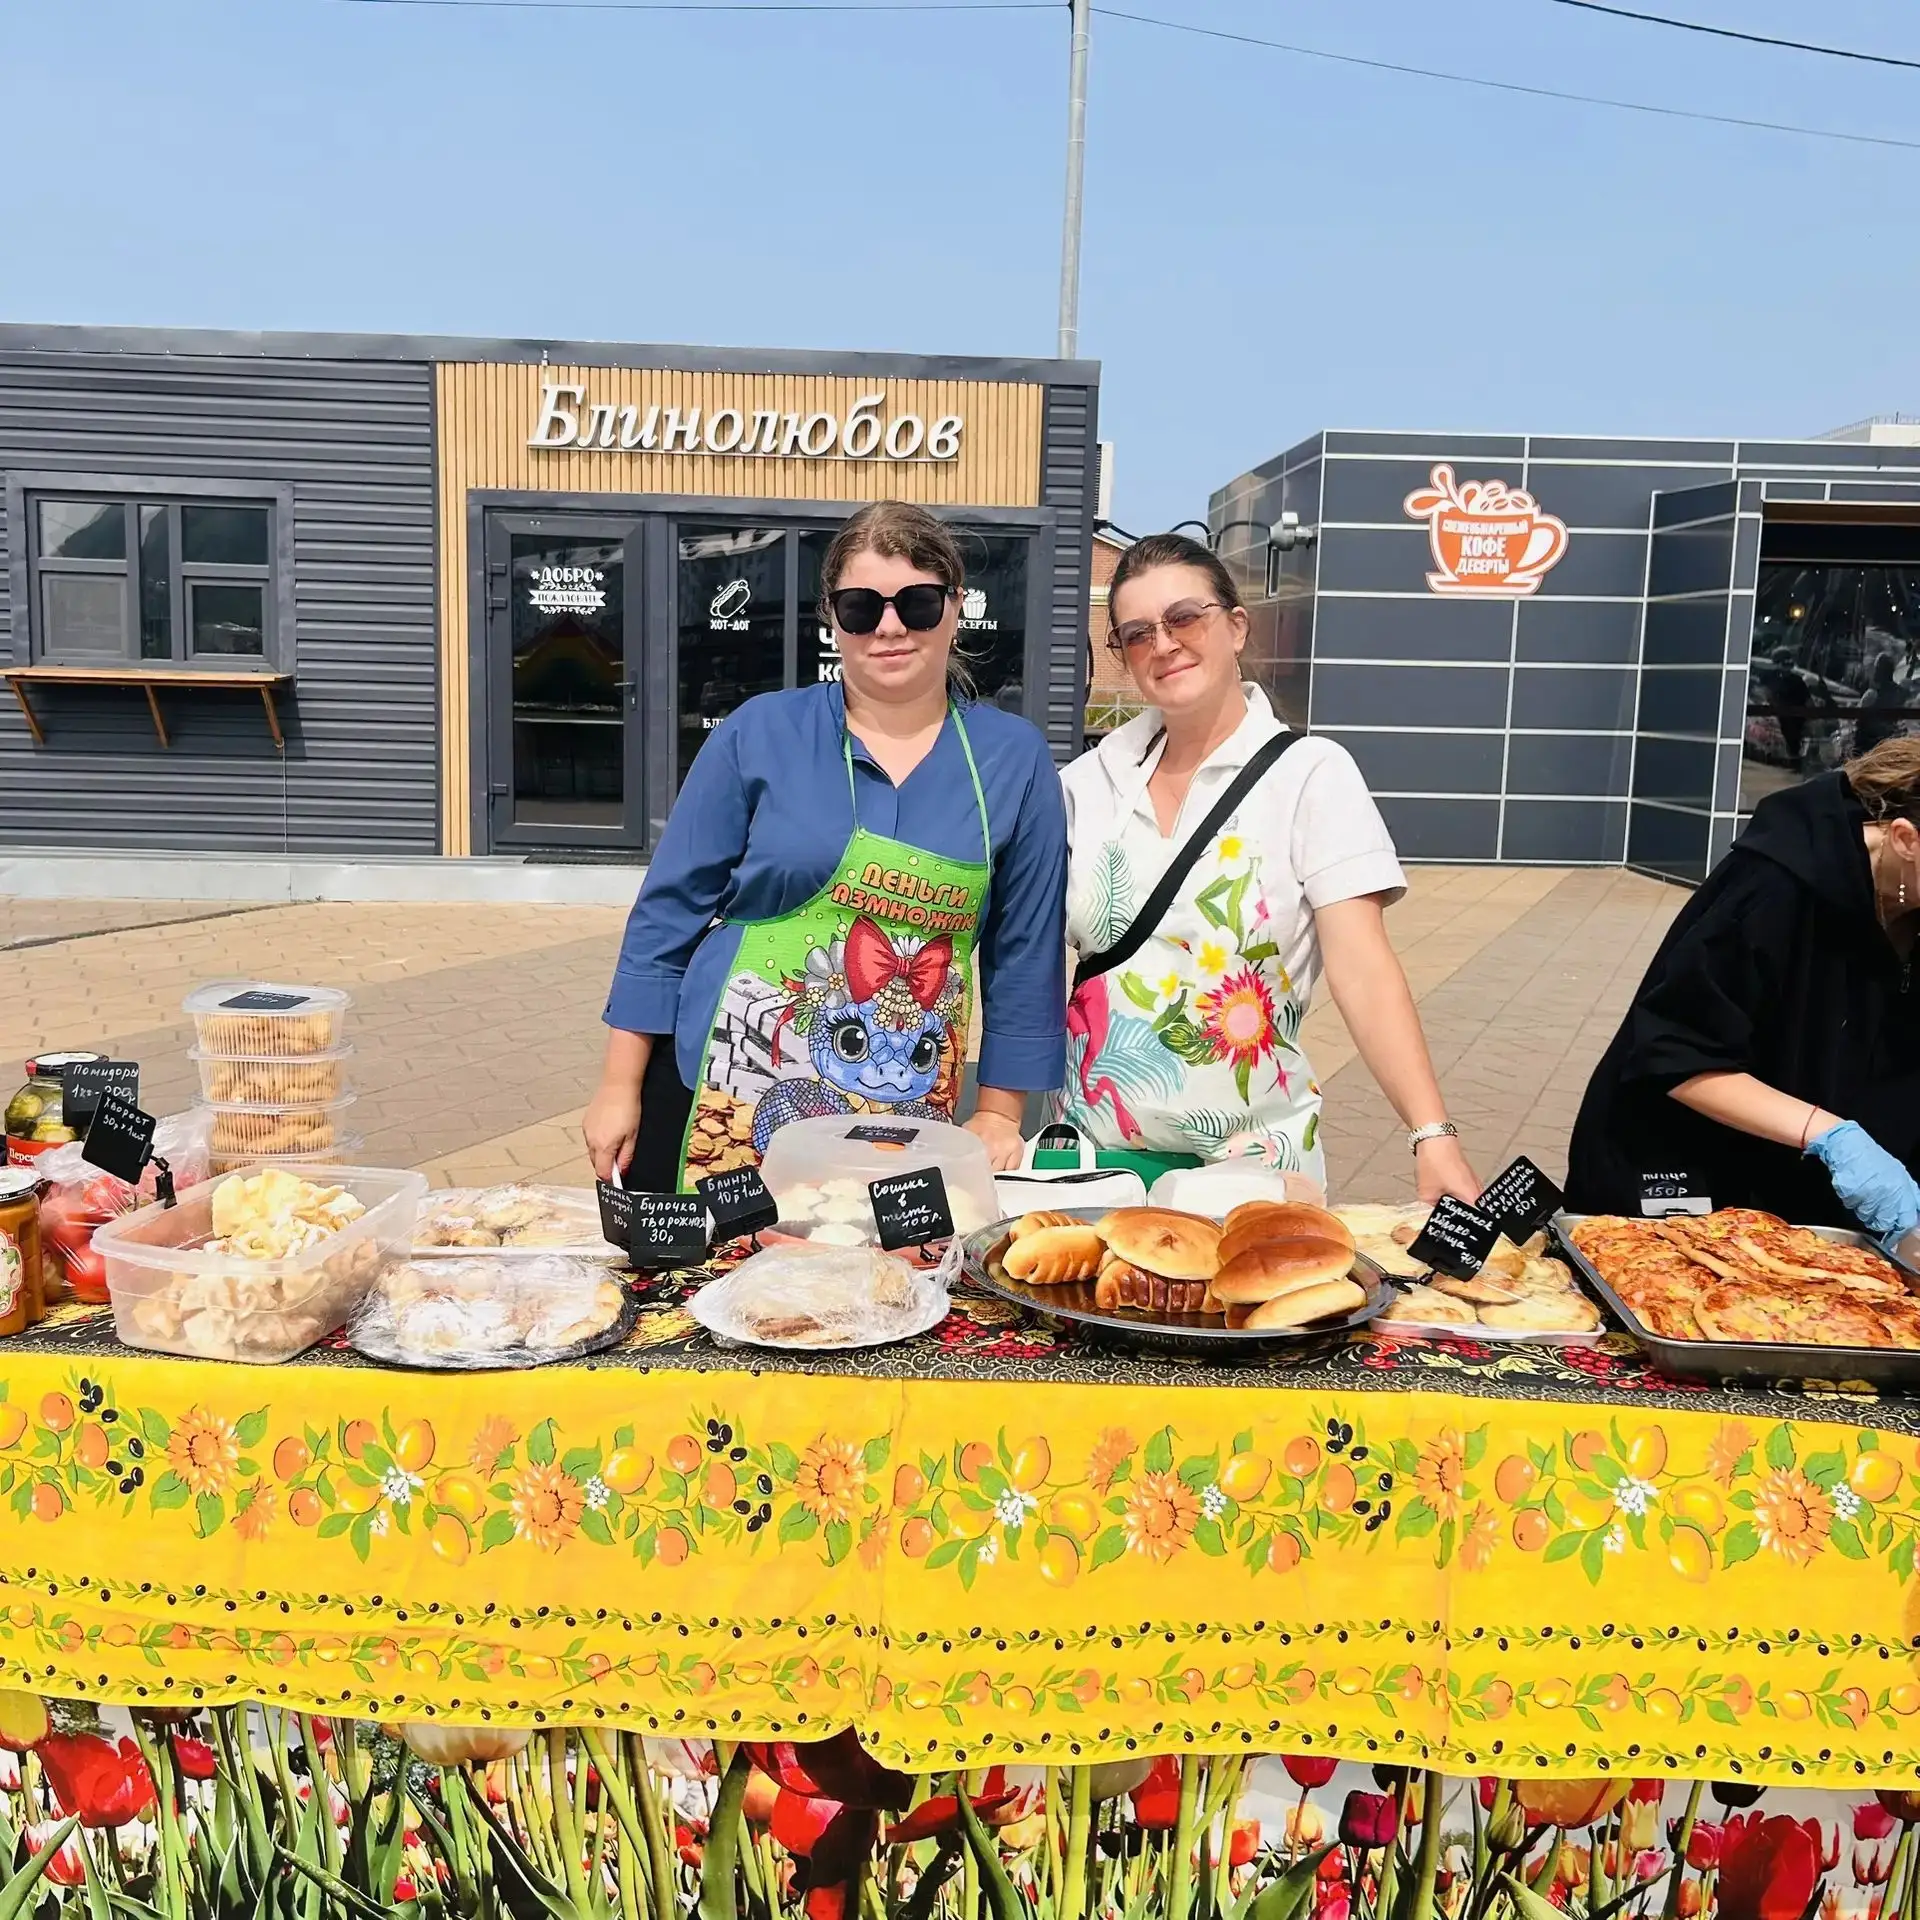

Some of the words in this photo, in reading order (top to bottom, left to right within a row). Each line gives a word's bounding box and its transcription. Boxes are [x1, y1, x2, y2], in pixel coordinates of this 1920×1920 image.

[527, 384, 964, 460] Блинолюбов
[1461, 536, 1507, 557] КОФЕ
[540, 567, 594, 583] ДОБРО
[1455, 558, 1509, 575] ДЕСЕРТЫ
[957, 620, 998, 630] ЕСЕРТЫ
[860, 862, 969, 908] ДЕНЬГИ
[707, 1171, 751, 1192] Блины
[640, 1197, 698, 1215] Булочка
